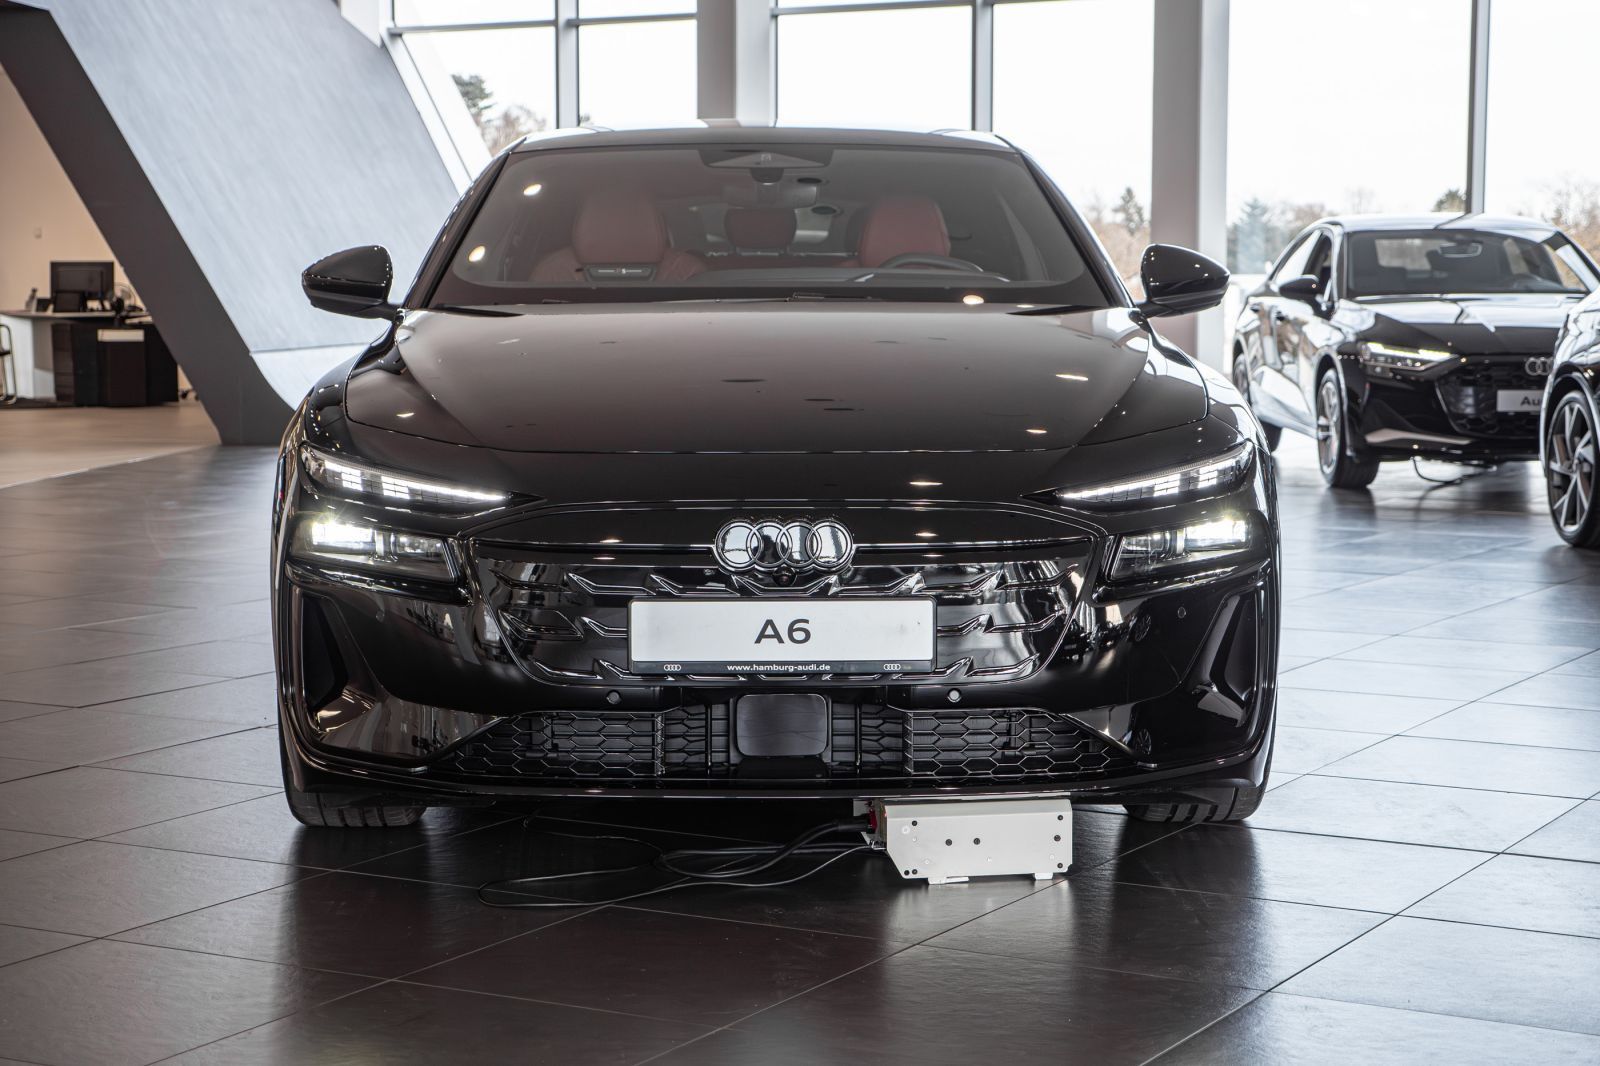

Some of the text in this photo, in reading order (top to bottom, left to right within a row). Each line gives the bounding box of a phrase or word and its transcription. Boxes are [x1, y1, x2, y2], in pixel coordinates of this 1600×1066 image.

[1520, 396, 1541, 406] Au
[754, 618, 812, 645] A6
[726, 663, 831, 673] www.hamburg-audi.de
